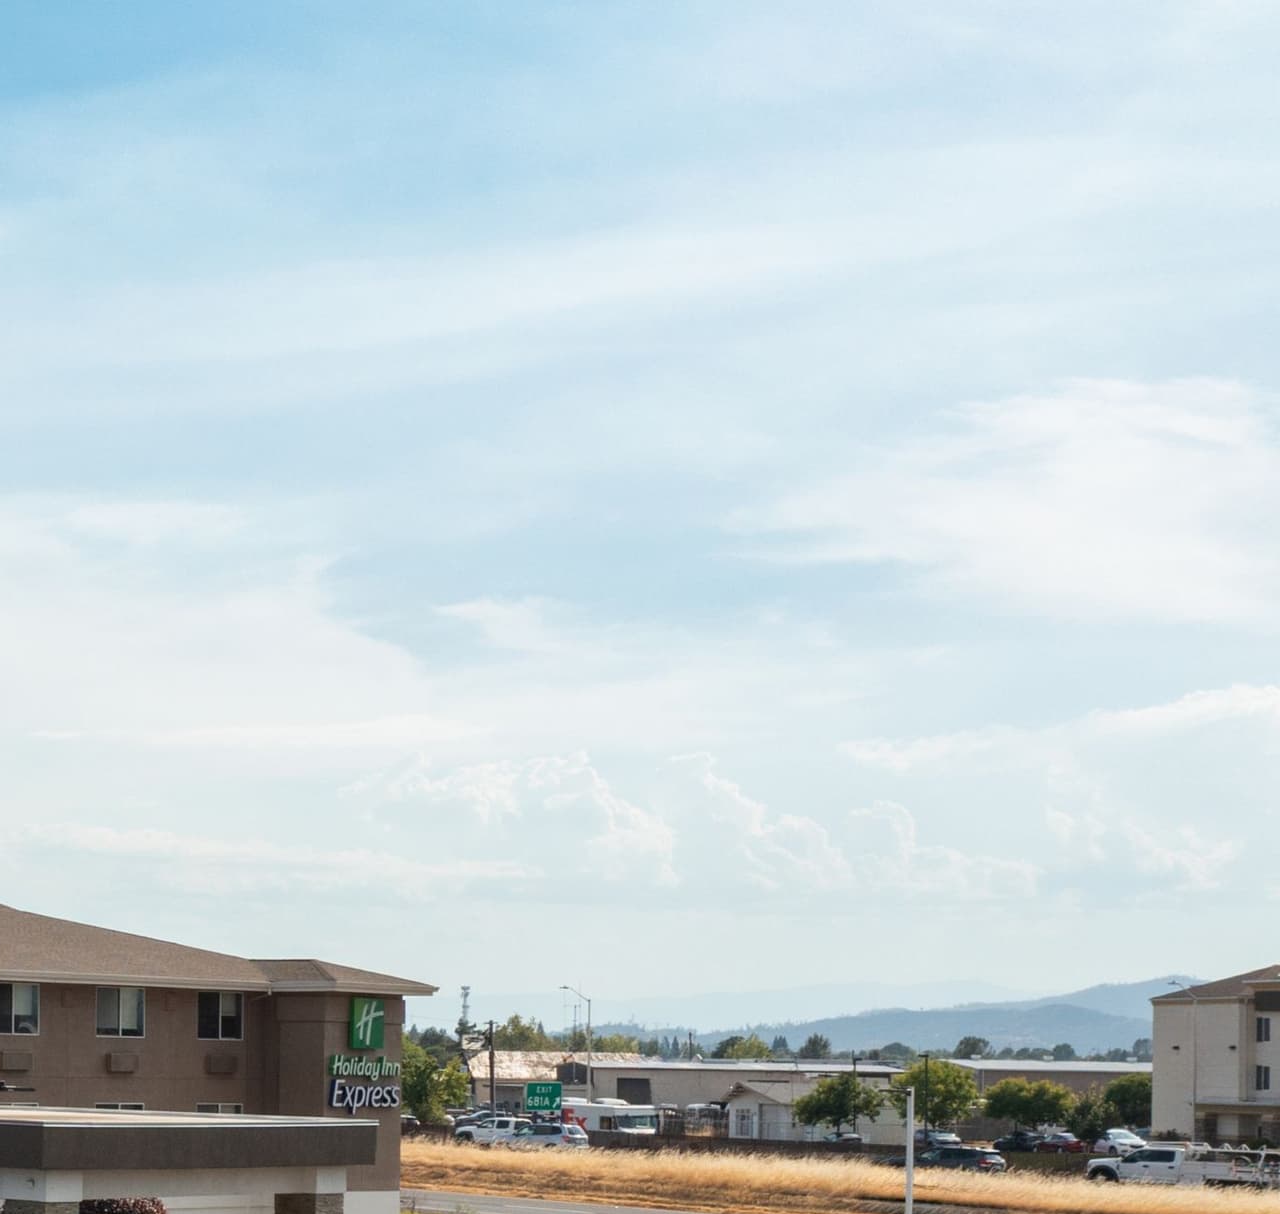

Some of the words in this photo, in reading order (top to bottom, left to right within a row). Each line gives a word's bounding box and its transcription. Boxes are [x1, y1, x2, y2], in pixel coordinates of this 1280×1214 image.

[333, 1055, 380, 1080] Holiday
[381, 1056, 400, 1075] Inn
[331, 1079, 400, 1114] Express
